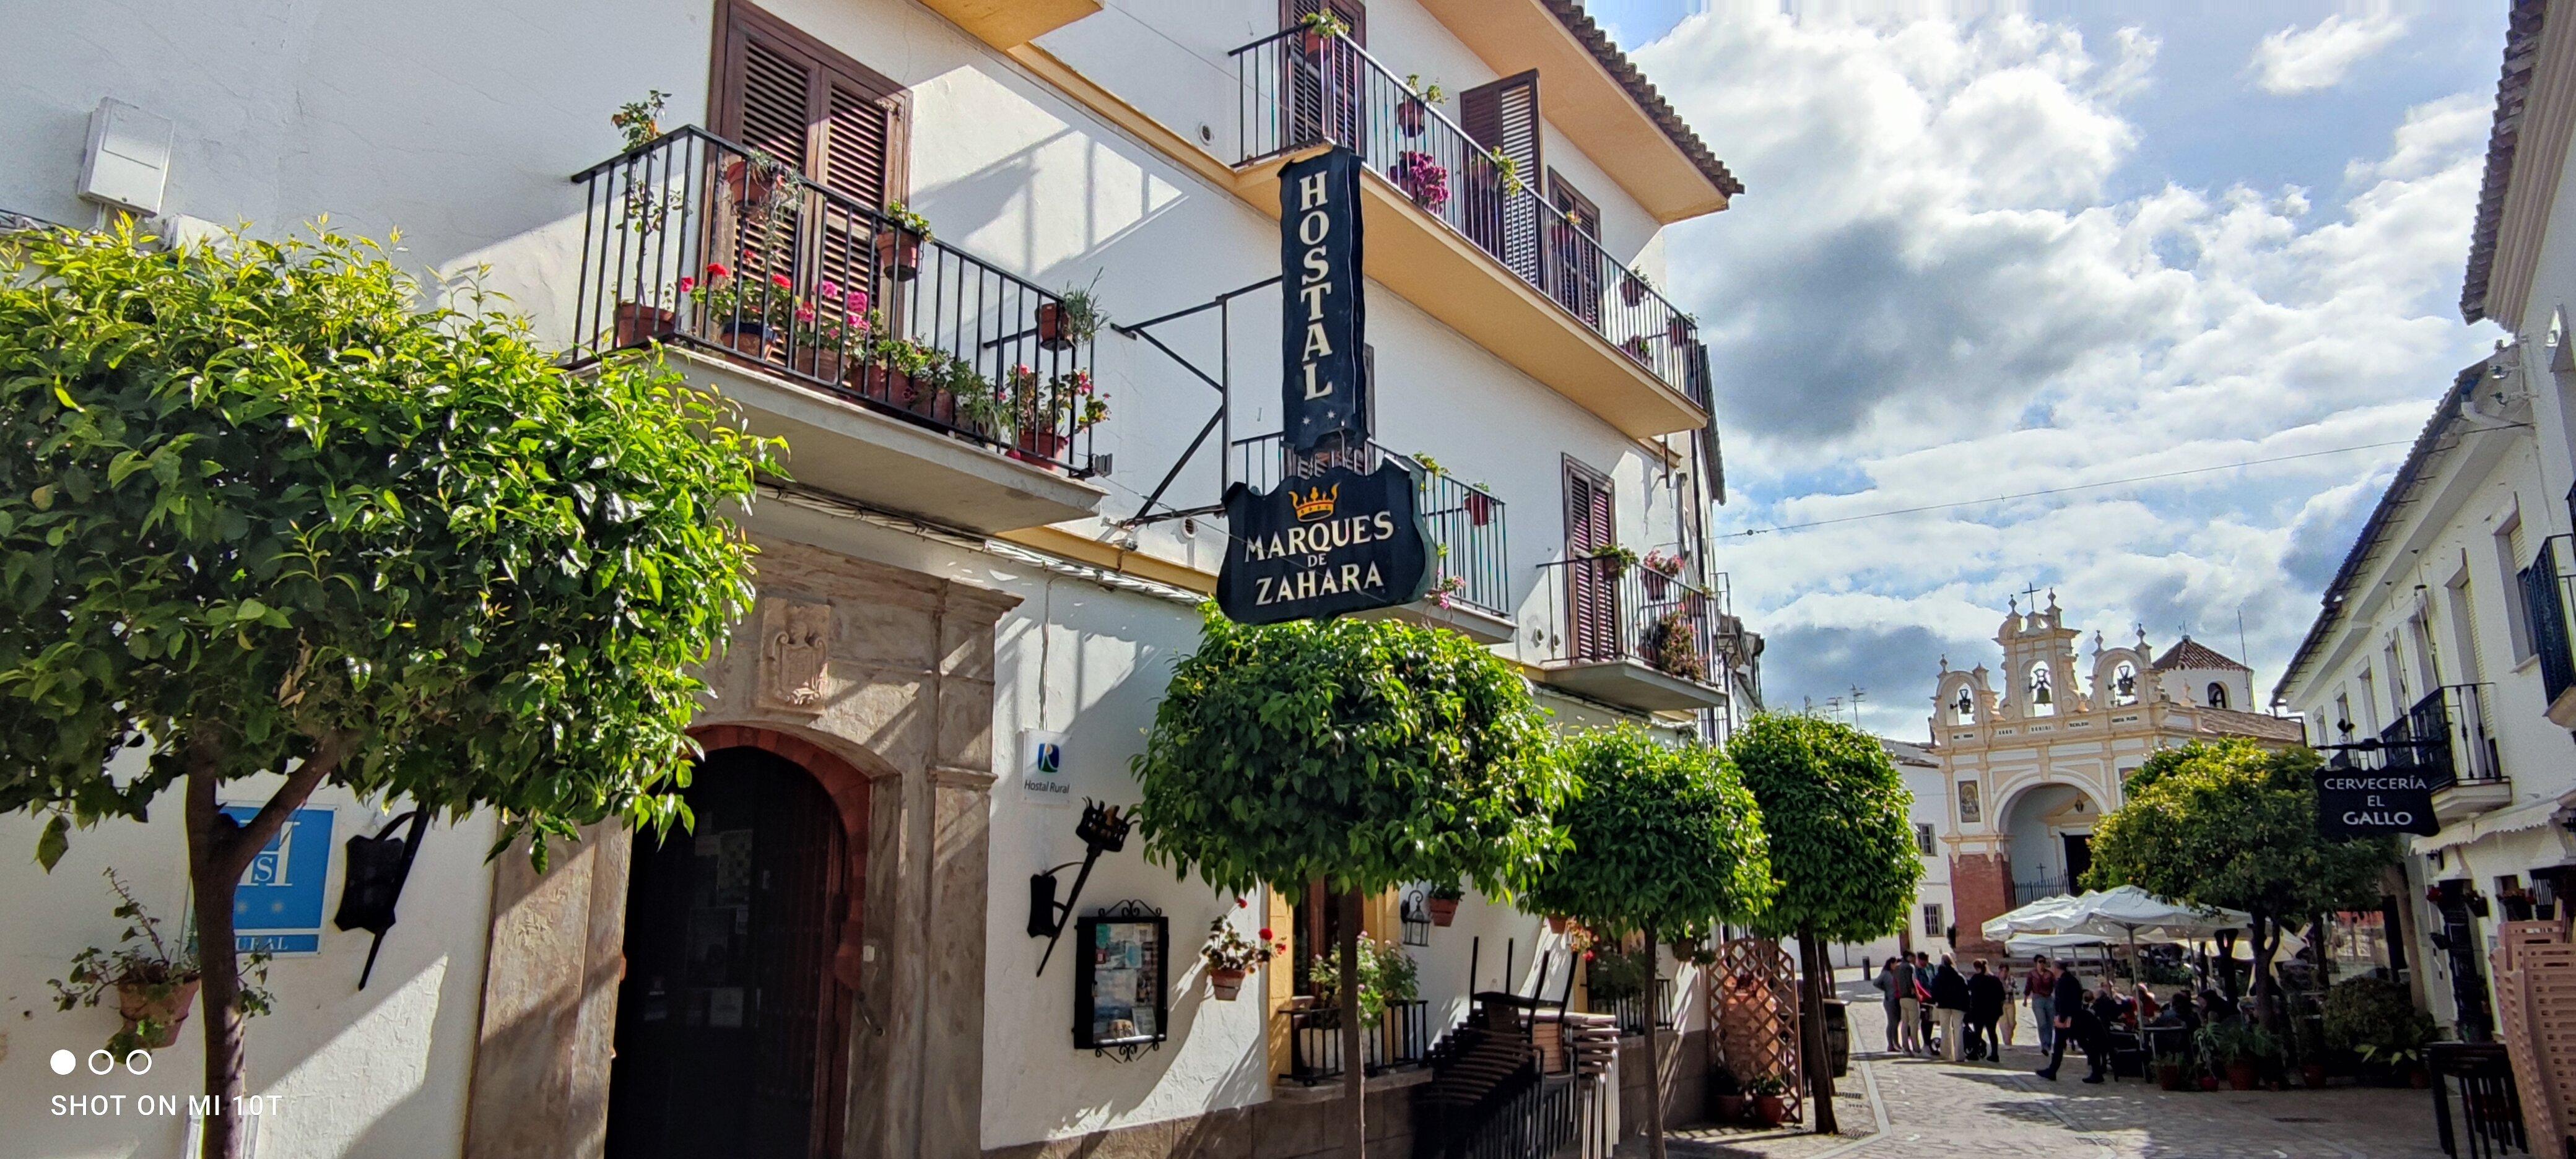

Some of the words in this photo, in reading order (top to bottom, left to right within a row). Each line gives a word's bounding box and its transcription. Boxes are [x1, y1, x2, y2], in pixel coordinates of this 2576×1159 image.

[1299, 170, 1333, 402] HOSTAL
[1244, 510, 1395, 563] MARQUES
[1307, 552, 1328, 567] DE
[1255, 560, 1385, 606] ZAHARA
[1024, 779, 1049, 792] Hostal
[1050, 782, 1070, 794] Rural
[2324, 775, 2427, 790] CERVECERÍA
[2367, 795, 2385, 807] EL
[2343, 811, 2413, 825] GALLO
